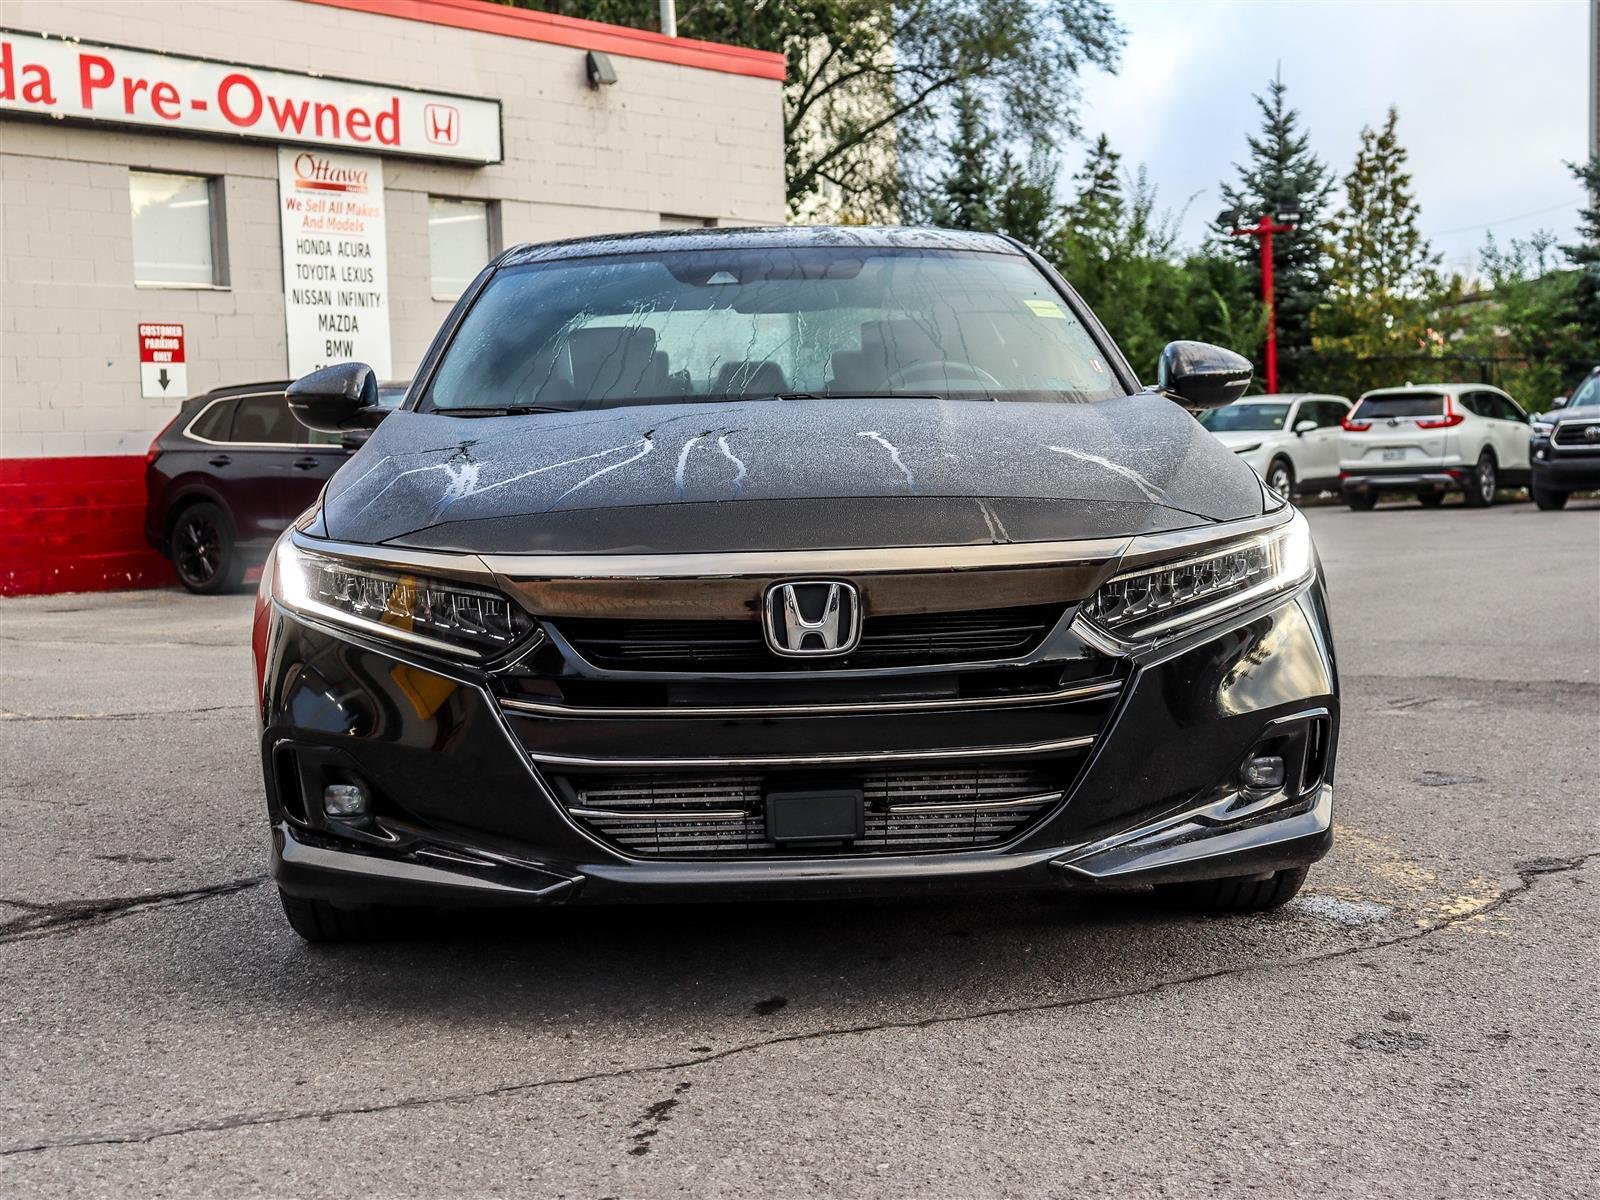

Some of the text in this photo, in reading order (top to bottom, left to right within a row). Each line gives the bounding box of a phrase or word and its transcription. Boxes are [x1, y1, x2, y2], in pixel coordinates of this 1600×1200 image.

[79, 53, 401, 146] Pre-Owned
[295, 152, 368, 183] Ottawa
[286, 198, 380, 217] We Sell All Makes
[302, 215, 365, 232] And Models
[296, 239, 371, 258] HONDA ACURA
[296, 264, 374, 283] TOYOTA LEXUS
[292, 289, 381, 308] NISSAN INFINITY
[140, 325, 182, 337] CUSTOMER
[318, 314, 360, 333] MAZDA
[145, 338, 179, 350] PARKING
[325, 340, 353, 358] BMW
[153, 351, 172, 362] ONLY
